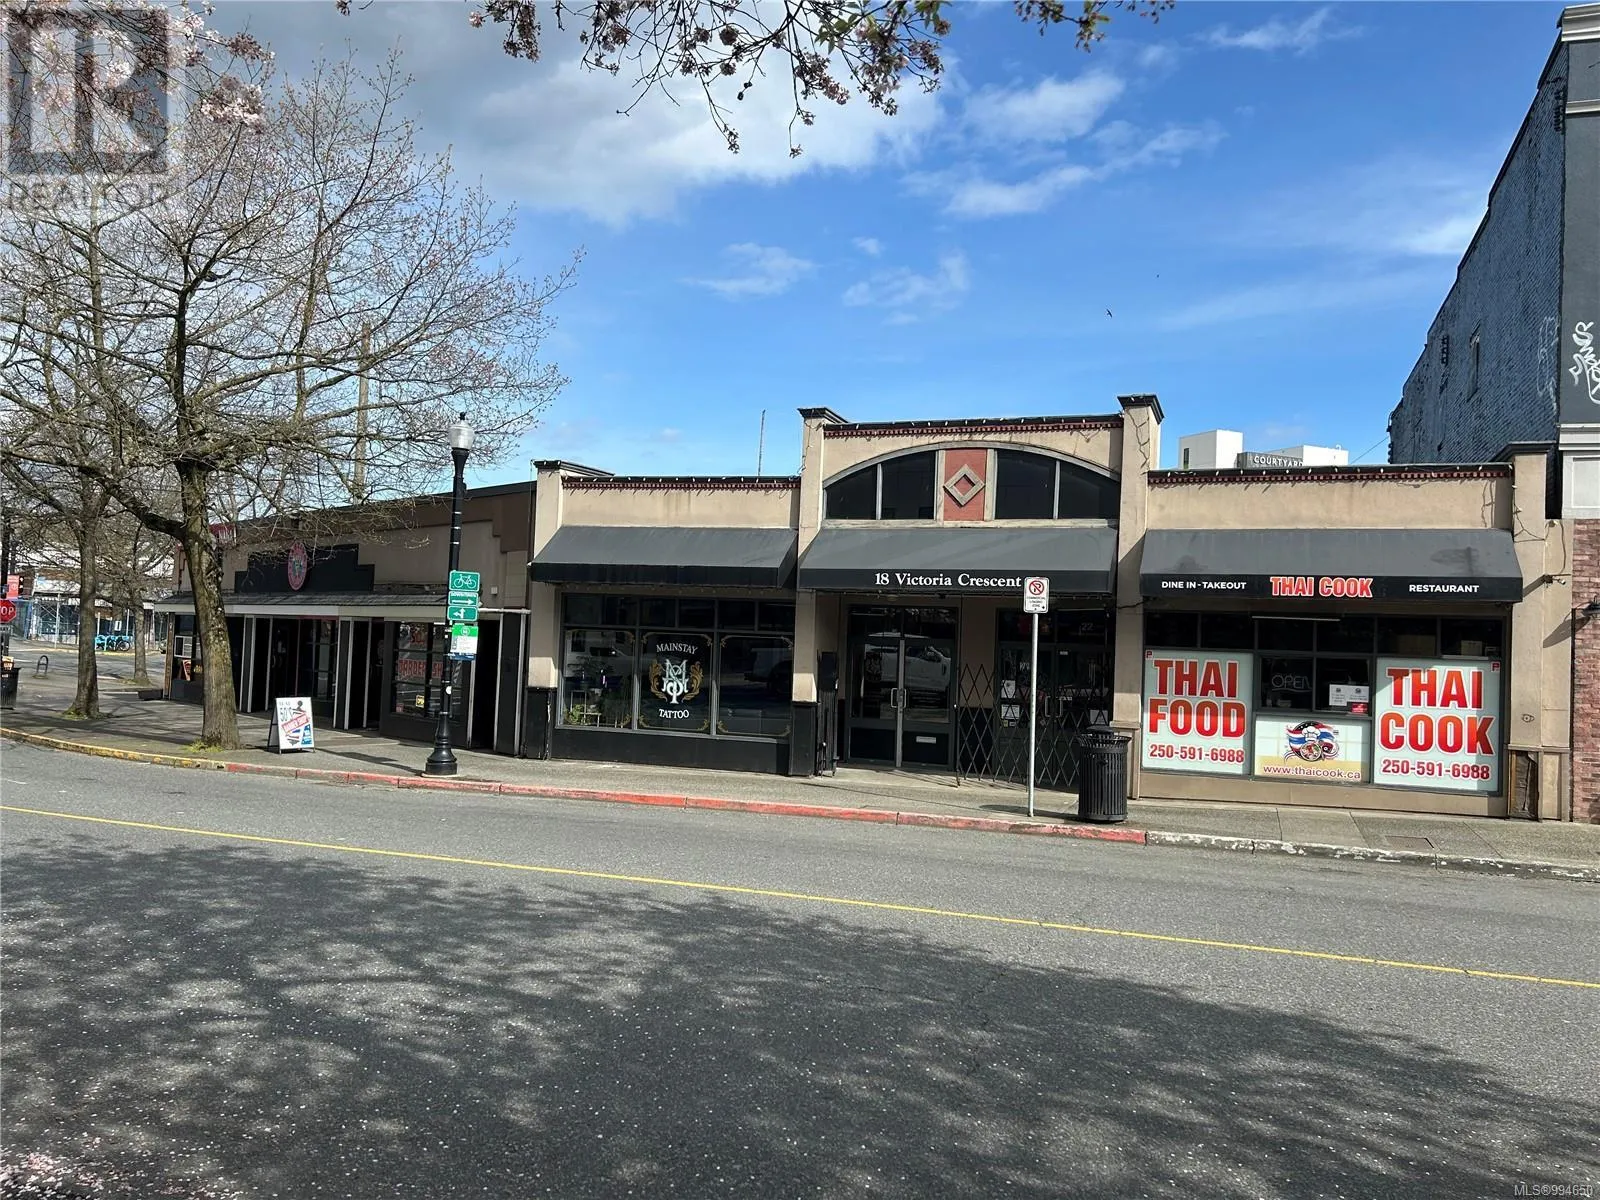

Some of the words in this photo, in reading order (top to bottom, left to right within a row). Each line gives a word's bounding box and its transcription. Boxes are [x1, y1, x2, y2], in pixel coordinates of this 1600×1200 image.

[874, 572, 890, 586] 18
[895, 572, 953, 587] Victoria
[957, 573, 1022, 587] Crescent
[1161, 581, 1184, 589] DINE
[1270, 576, 1315, 597] THAI
[1318, 577, 1374, 598] COOK
[1408, 584, 1480, 593] RESTAURANT
[656, 643, 699, 655] MAINSTAY
[1153, 658, 1239, 699] THAI
[1386, 667, 1484, 710] THAI
[659, 708, 690, 719] TATTOO
[1148, 697, 1247, 739] FOOD
[1379, 710, 1495, 756] COOK
[1149, 743, 1245, 764] 250-591-6988
[1263, 765, 1361, 779] www.thaicook.ca
[1381, 758, 1491, 780] 250-591-6988
